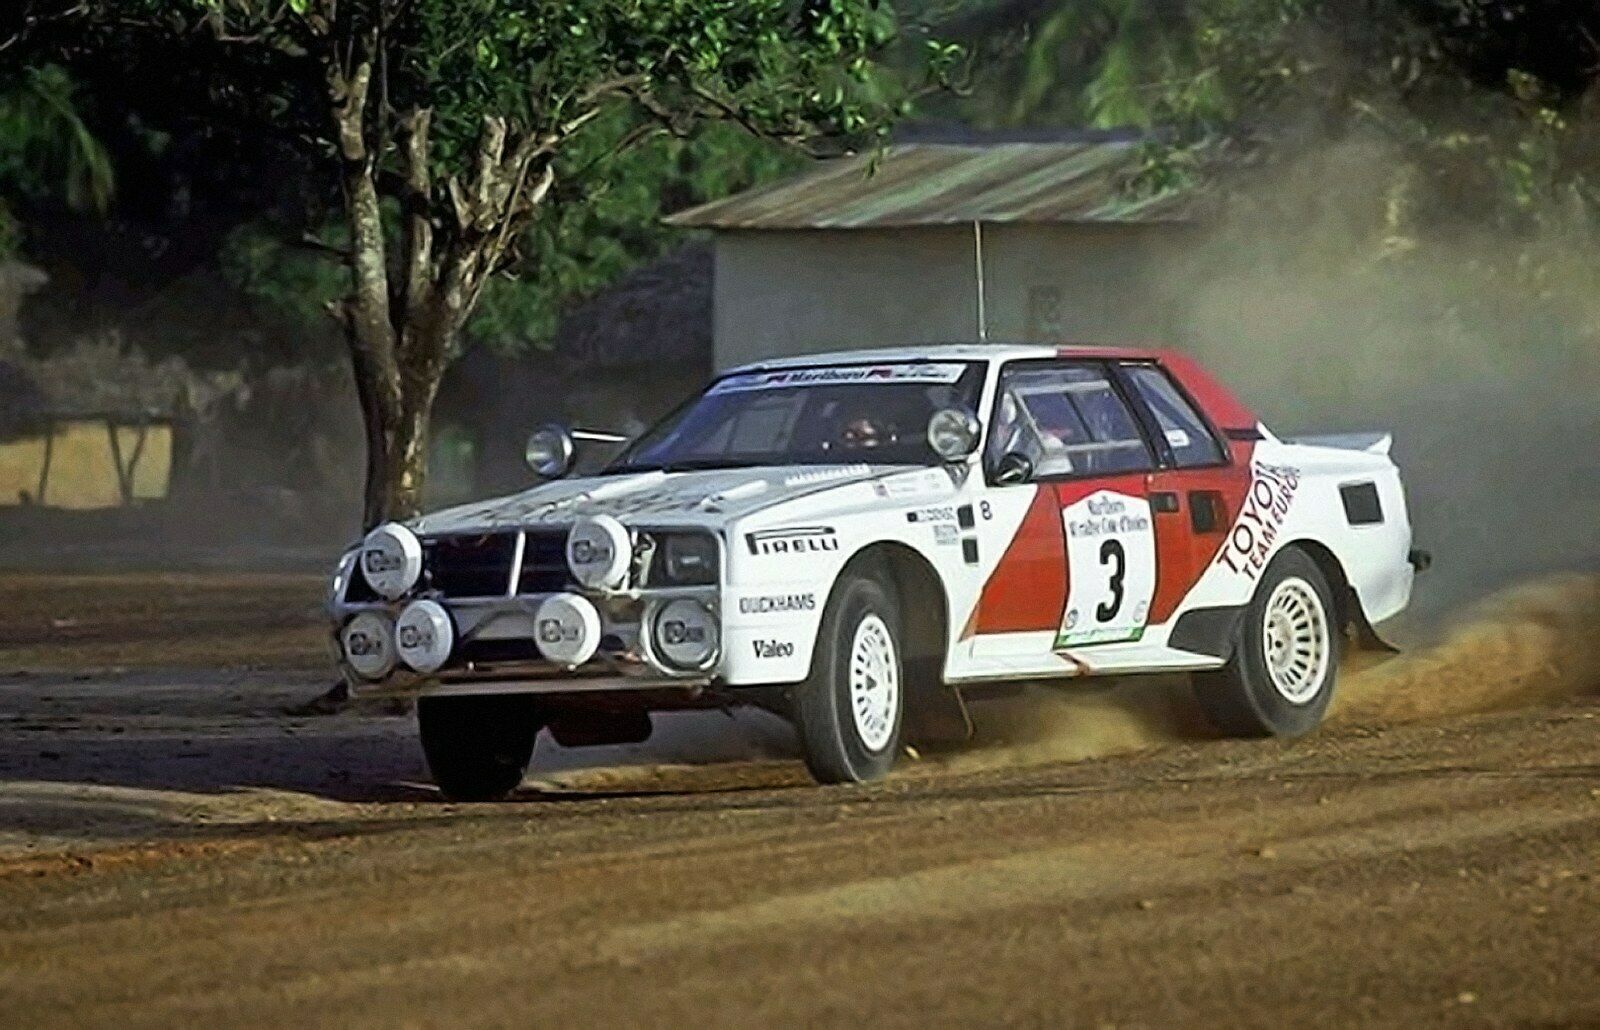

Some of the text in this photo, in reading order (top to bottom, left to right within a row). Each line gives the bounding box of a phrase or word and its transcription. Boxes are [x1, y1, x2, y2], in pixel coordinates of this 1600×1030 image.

[744, 526, 839, 555] PIRELLI
[1242, 520, 1277, 580] TEAM
[1096, 538, 1125, 624] 3
[739, 593, 816, 614] DUCKHAMS
[752, 639, 795, 658] Valeo
